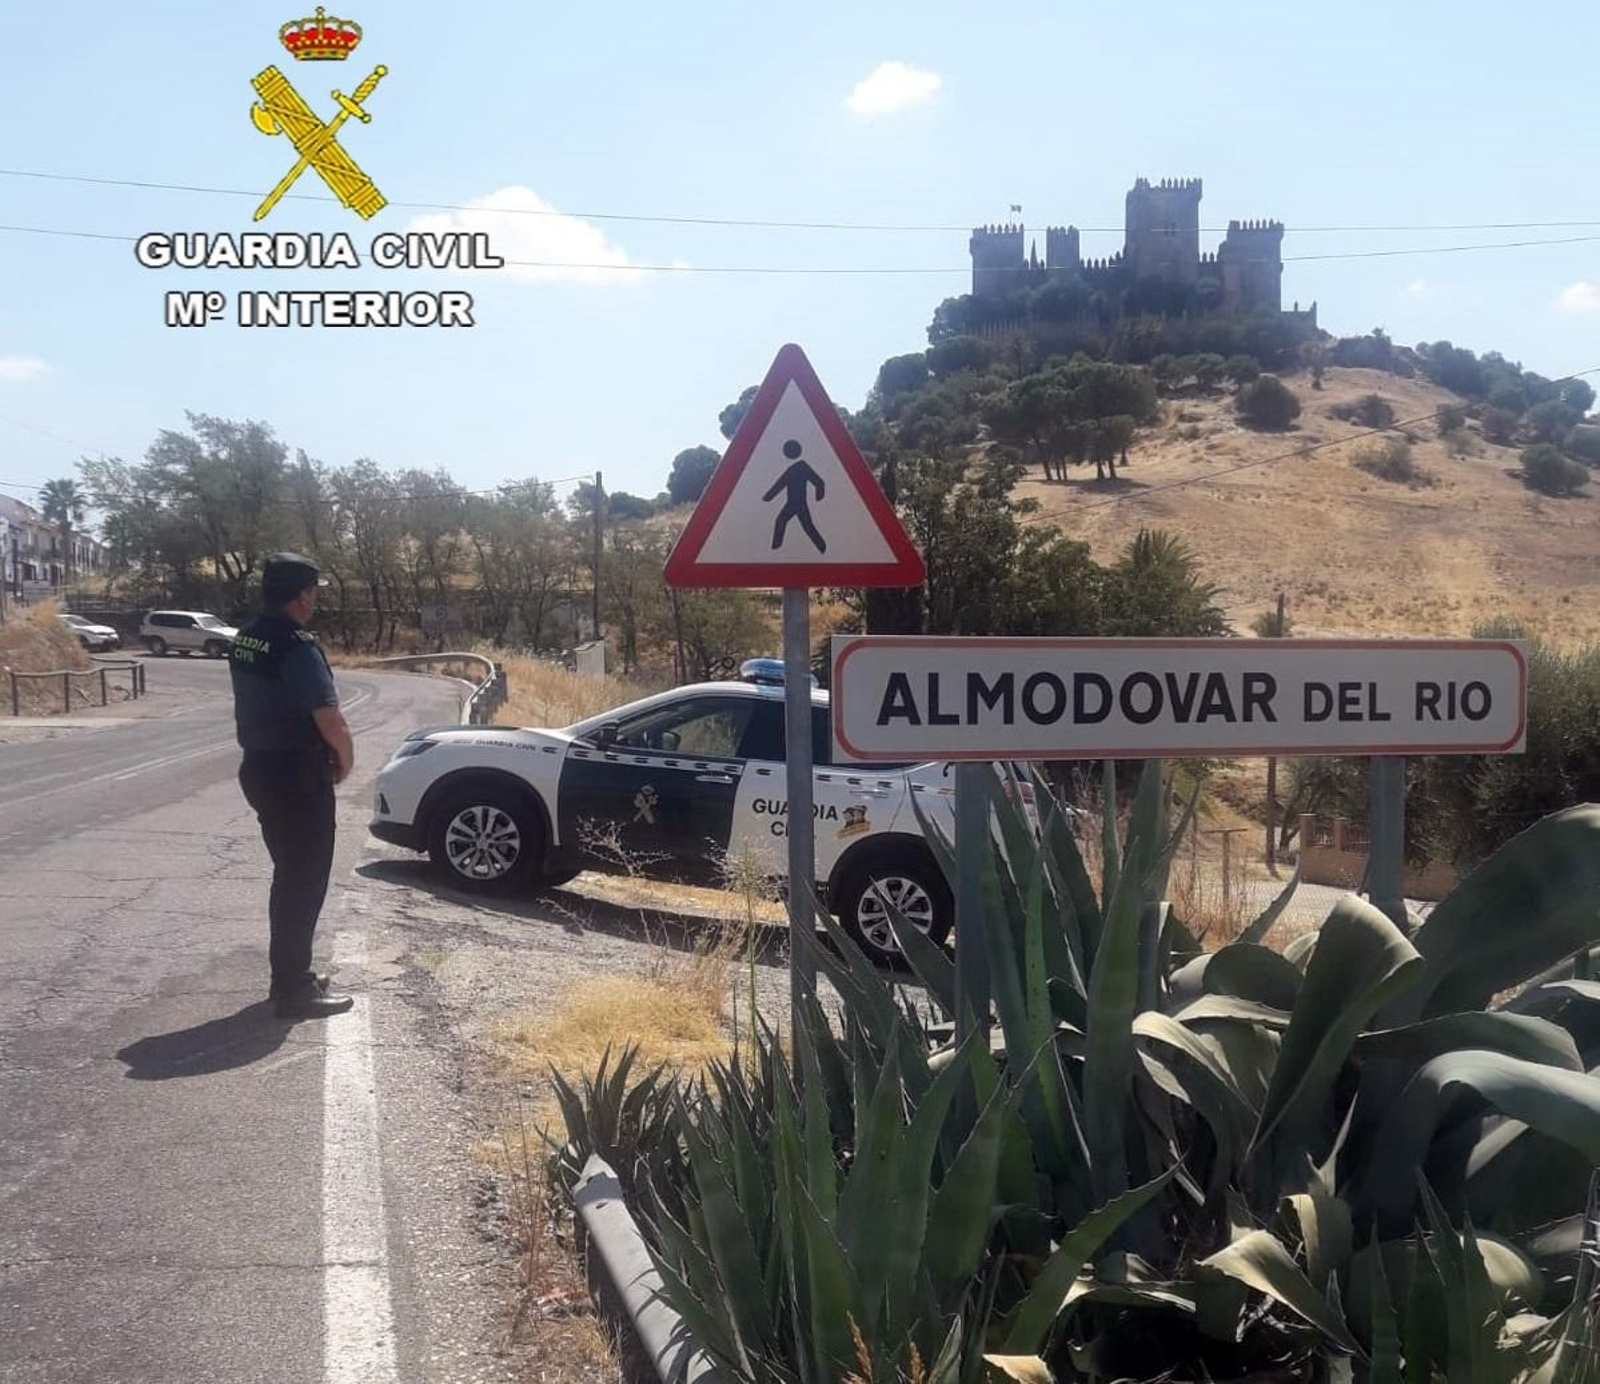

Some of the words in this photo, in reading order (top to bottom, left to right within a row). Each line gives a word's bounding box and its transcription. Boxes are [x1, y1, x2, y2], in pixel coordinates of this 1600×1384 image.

[875, 671, 1278, 726] ALMODOVAR
[1303, 681, 1391, 723] DEL
[1415, 681, 1492, 722] RIO
[752, 798, 838, 821] GUADIA
